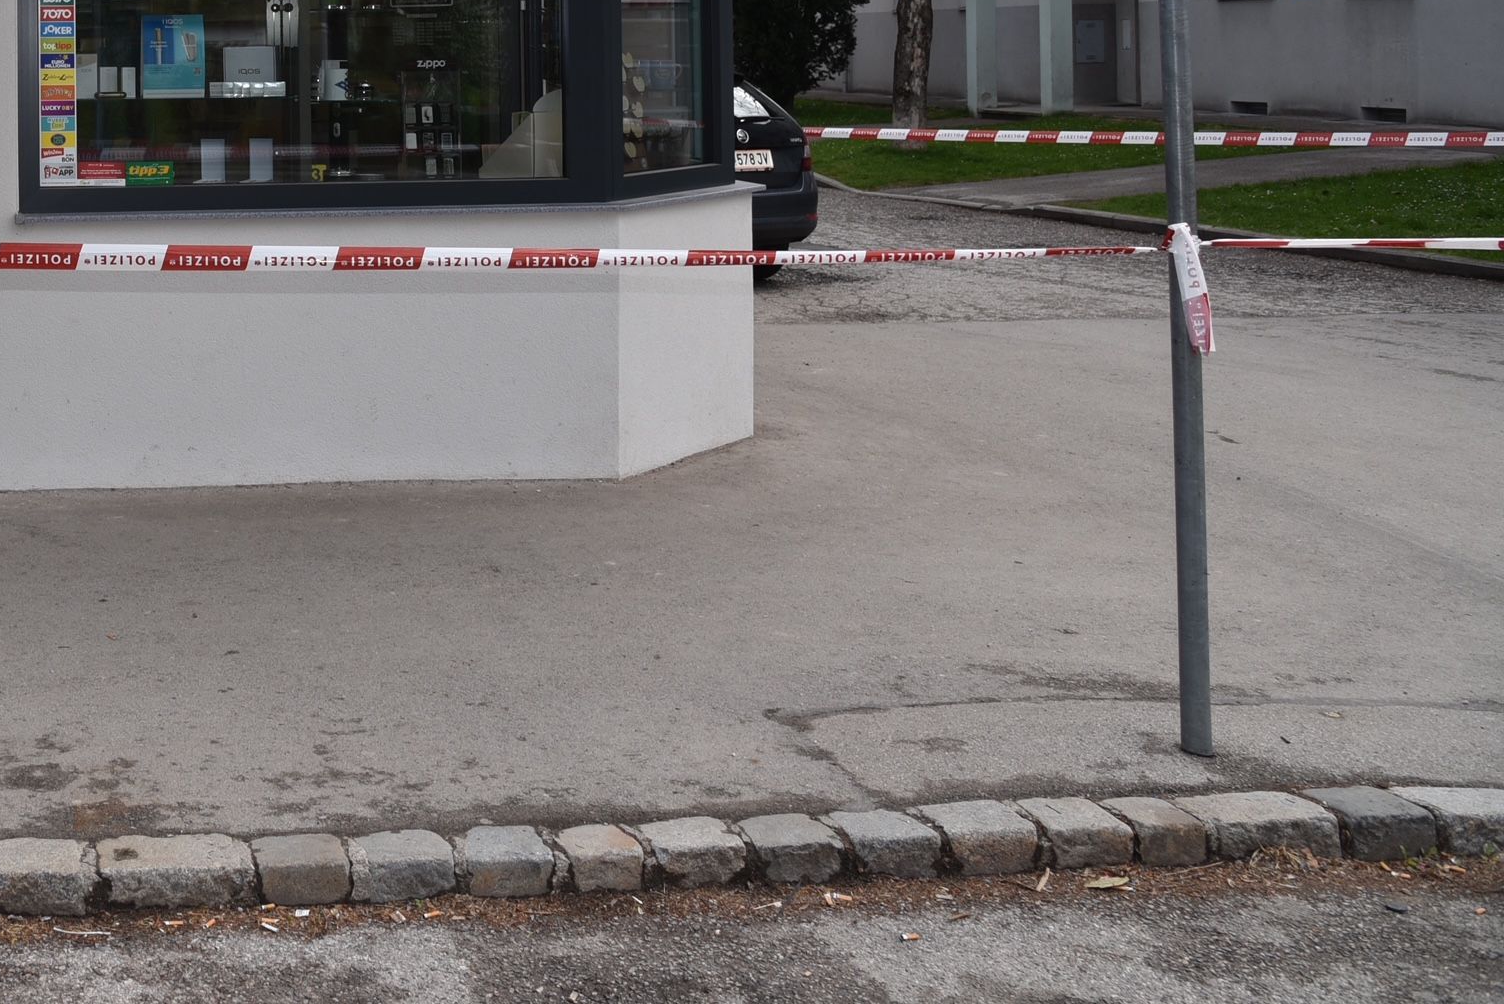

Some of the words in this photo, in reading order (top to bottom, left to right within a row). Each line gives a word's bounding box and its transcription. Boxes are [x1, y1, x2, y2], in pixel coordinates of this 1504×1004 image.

[42, 9, 72, 19] TOTO
[42, 24, 72, 35] JOKER
[128, 165, 170, 177] tipp3
[11, 253, 72, 265] POLIZEI
[94, 254, 156, 266] POLIZEI
[179, 255, 241, 267] POLIZEI
[265, 256, 327, 267] POLIZEI
[351, 256, 415, 268] POLIZEI
[438, 256, 502, 268] POLIZEI
[525, 256, 590, 268] POLIZEI
[613, 255, 678, 266] POLIZEI
[703, 254, 767, 266] POLIZEI
[791, 253, 856, 264] POLIZEI
[881, 252, 946, 262] POLIZEI
